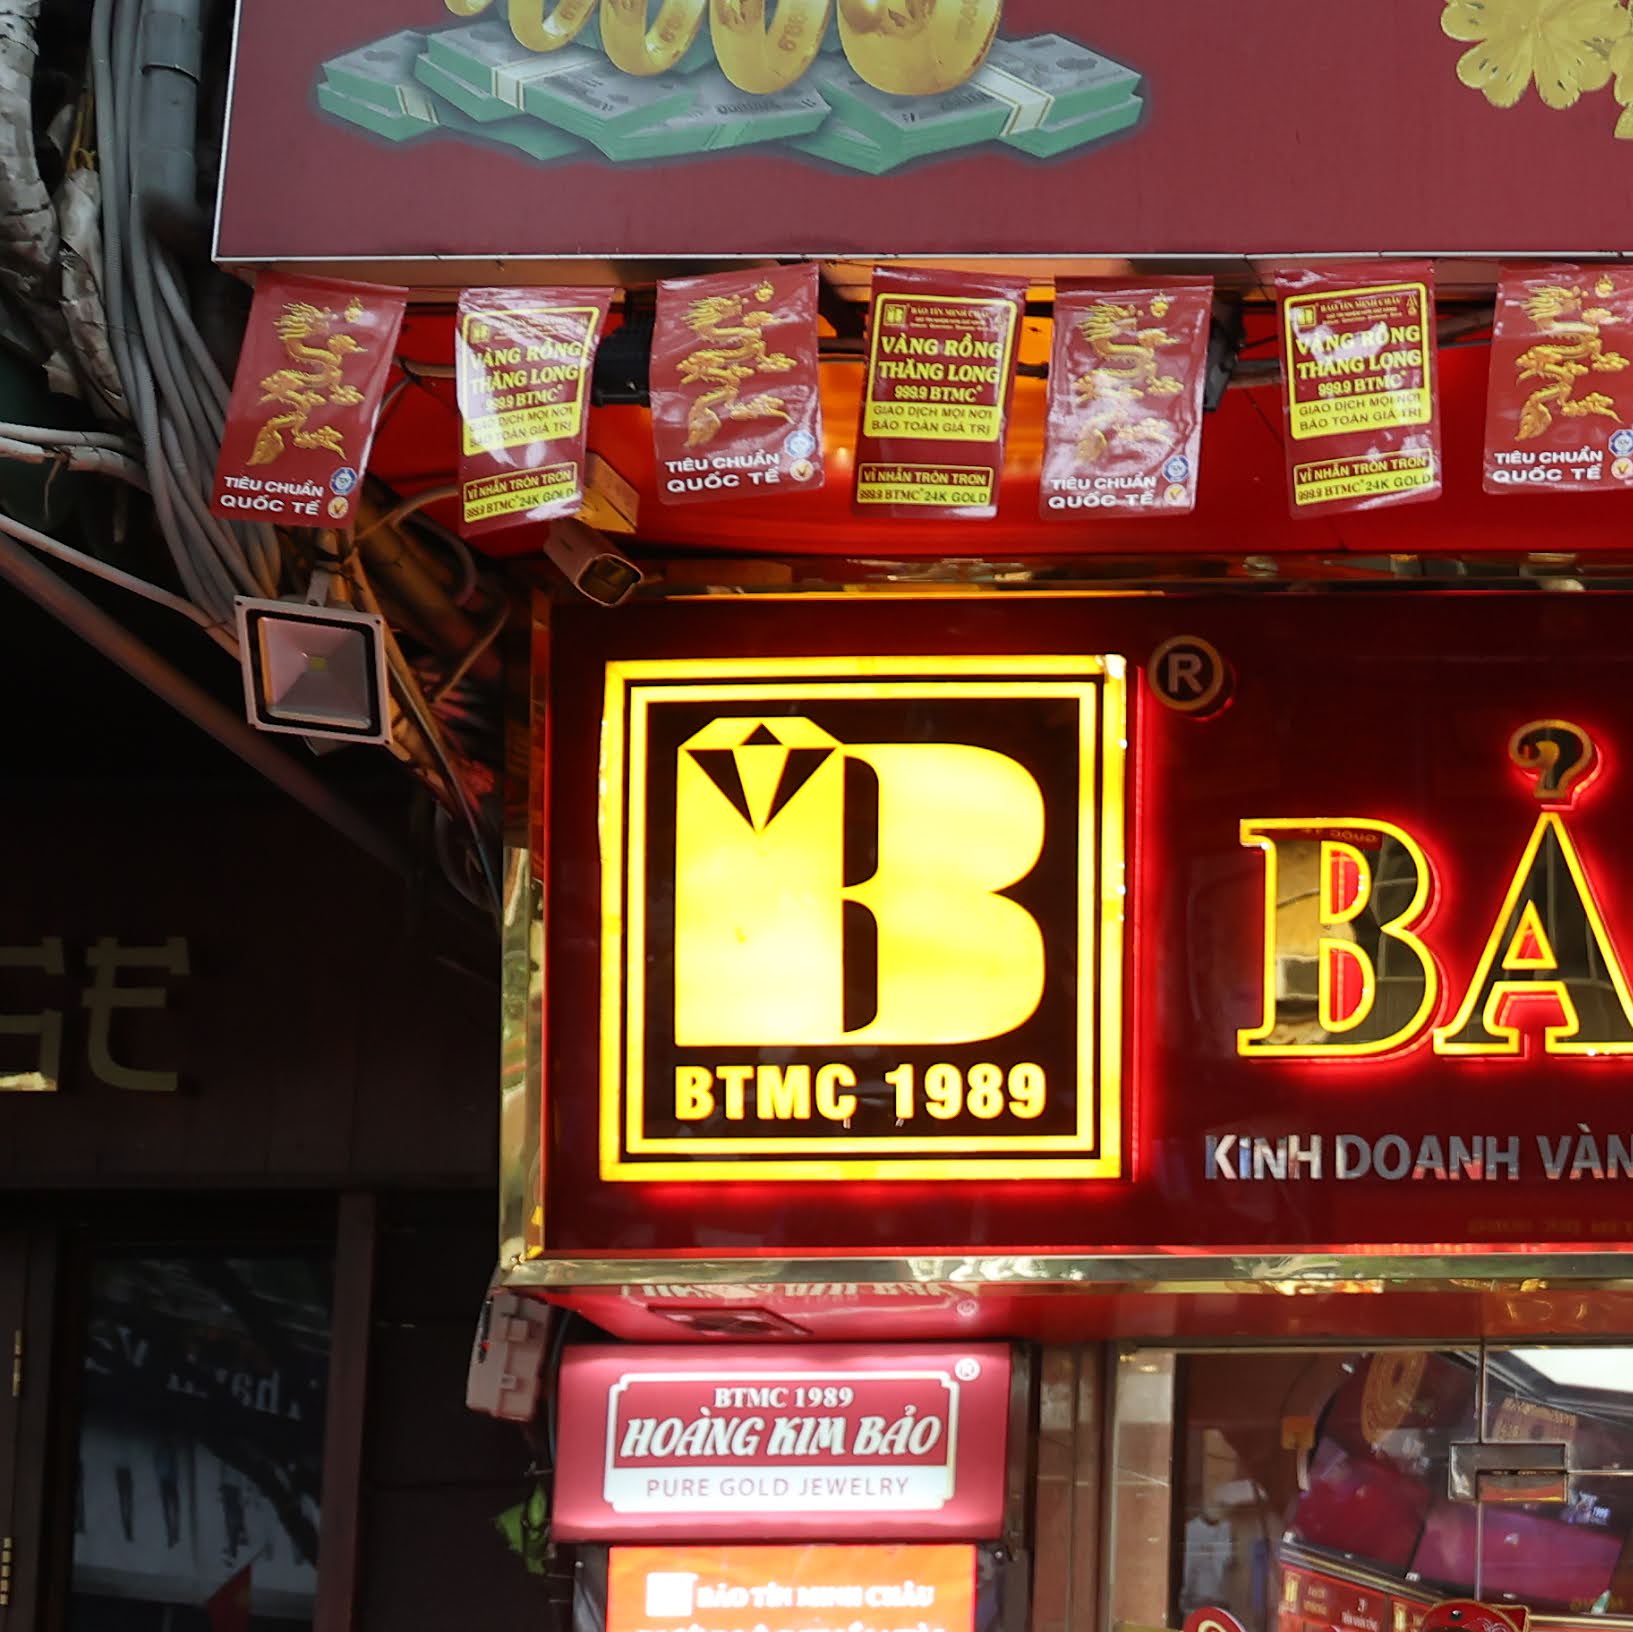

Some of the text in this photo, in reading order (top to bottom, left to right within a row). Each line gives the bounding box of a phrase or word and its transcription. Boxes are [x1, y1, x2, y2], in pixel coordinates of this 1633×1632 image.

[881, 332, 1003, 359] VÀNG RỒNG
[879, 358, 1000, 384] THĂNG LONG
[874, 405, 904, 416] GIAO
[224, 476, 261, 492] TIÊU
[220, 494, 320, 516] QUỐC TẾ
[675, 1061, 1047, 1119] BTMC 1989
[1336, 1133, 1519, 1180] DOANH
[714, 1386, 854, 1408] BTMC 1989
[620, 1404, 942, 1458] HOÀNG KIM BẢO
[646, 1476, 910, 1498] PURE GOLD JEWELRY
